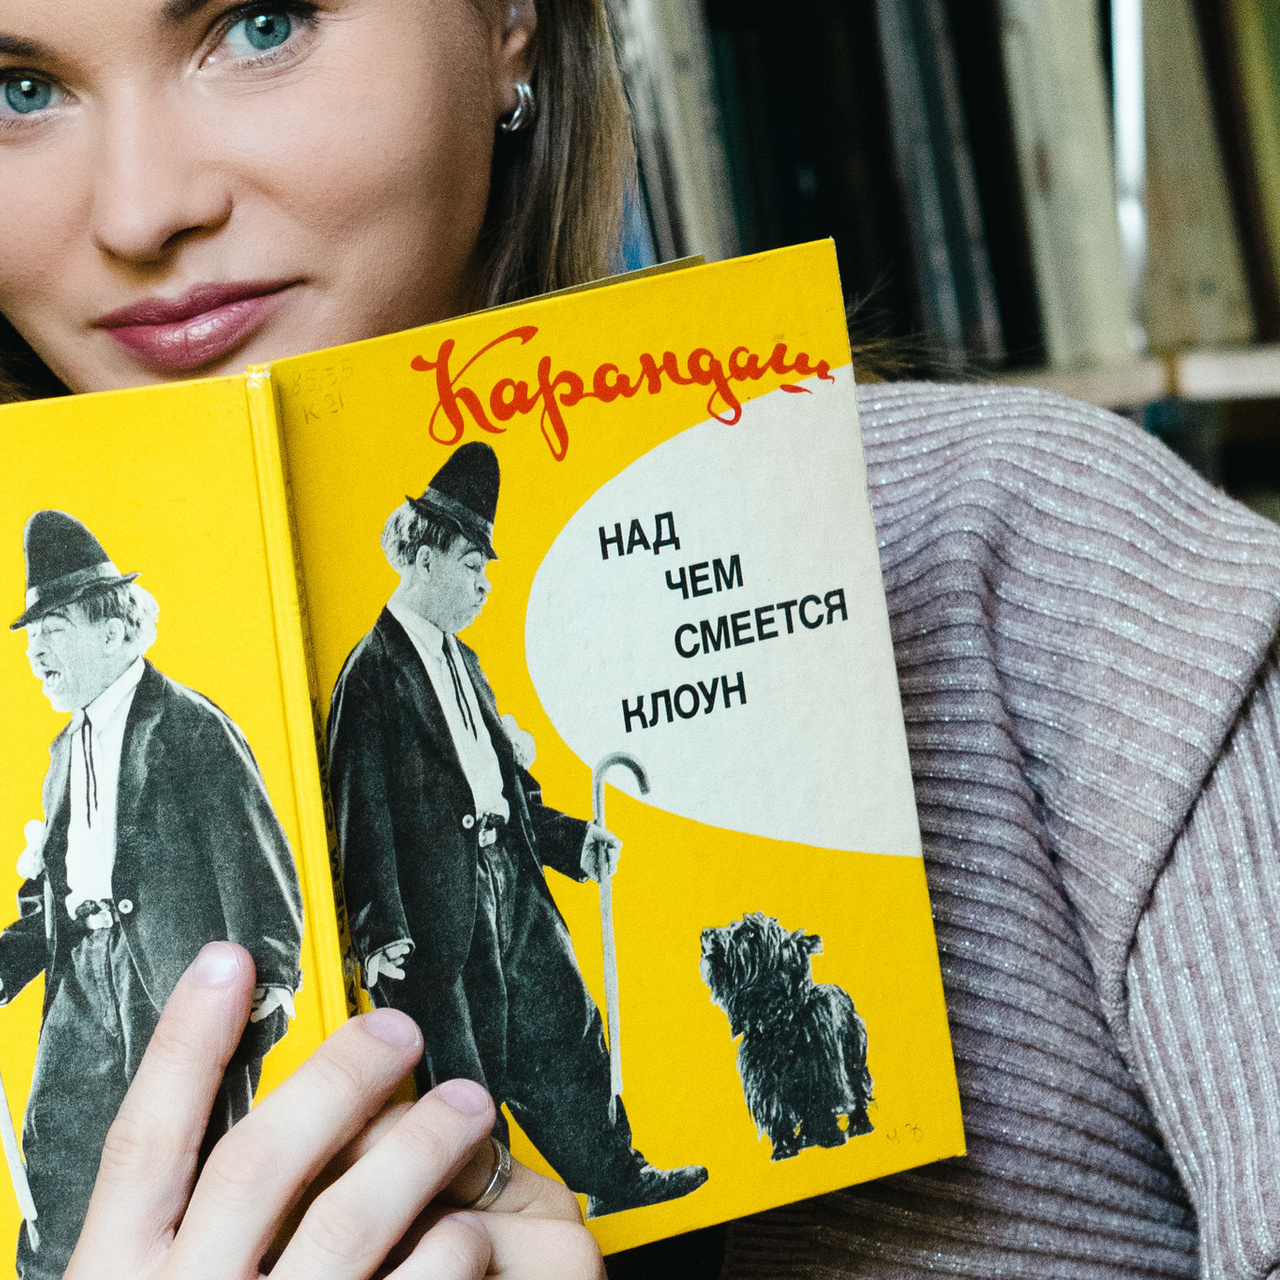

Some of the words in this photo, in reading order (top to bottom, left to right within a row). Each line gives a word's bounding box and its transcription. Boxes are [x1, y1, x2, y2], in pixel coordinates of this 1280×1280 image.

[410, 324, 835, 462] Карандаш
[598, 511, 681, 561] НАД
[665, 554, 744, 600] ЧЕМ
[674, 588, 849, 658] СМЕЕТСЯ
[622, 671, 747, 733] КЛОУН
